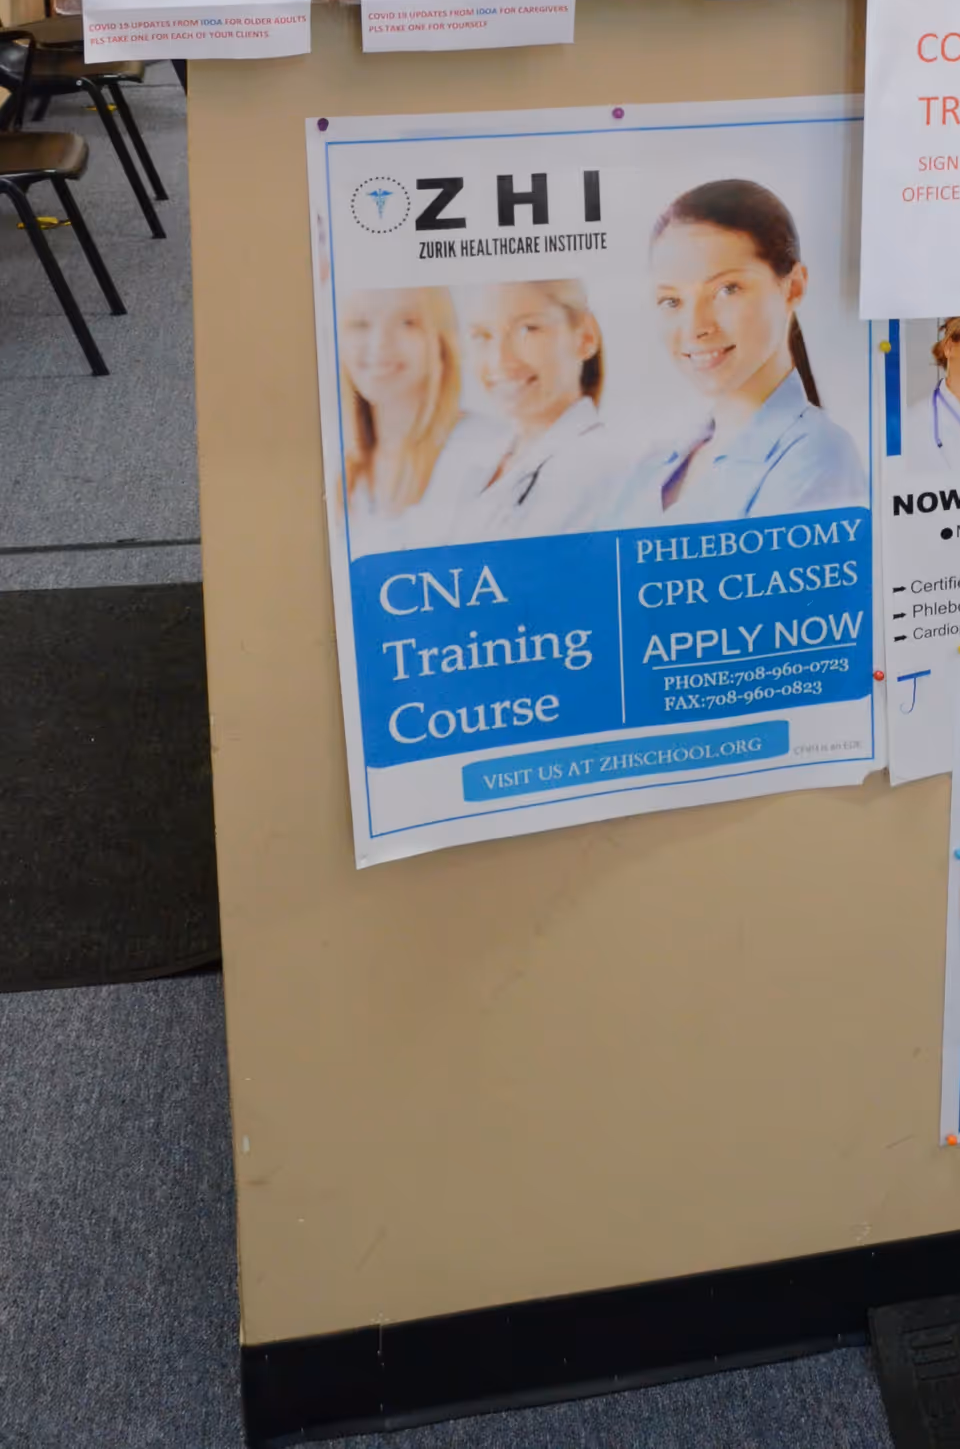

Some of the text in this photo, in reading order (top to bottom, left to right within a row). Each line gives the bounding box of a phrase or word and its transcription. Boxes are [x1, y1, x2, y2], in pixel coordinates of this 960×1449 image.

[368, 5, 569, 20] COVID 19 UPDATES FROM IDOA FOR CAREGIVERS
[368, 25, 384, 33] PLS
[385, 24, 406, 32] TAKE
[408, 24, 426, 32] ONE
[446, 20, 488, 30] YOURSELF
[918, 155, 959, 172] SIGN
[415, 170, 601, 231] Z H I
[902, 185, 960, 203] OFFICE
[420, 232, 608, 260] ZURIK HEALTHCARE INSTITUTE
[636, 519, 862, 564] PHLEBOTOMY
[380, 566, 508, 616] CNA
[638, 560, 858, 608] CPR CLASSES
[383, 624, 592, 681] Training
[642, 610, 864, 664] APPLY NOW
[664, 657, 849, 692] PHONE:708-960-0723
[664, 679, 822, 712] FAX:708-960-0823
[389, 693, 559, 744] Course
[483, 736, 762, 790] VISIT US AT ZHISCHOOL.ORG
